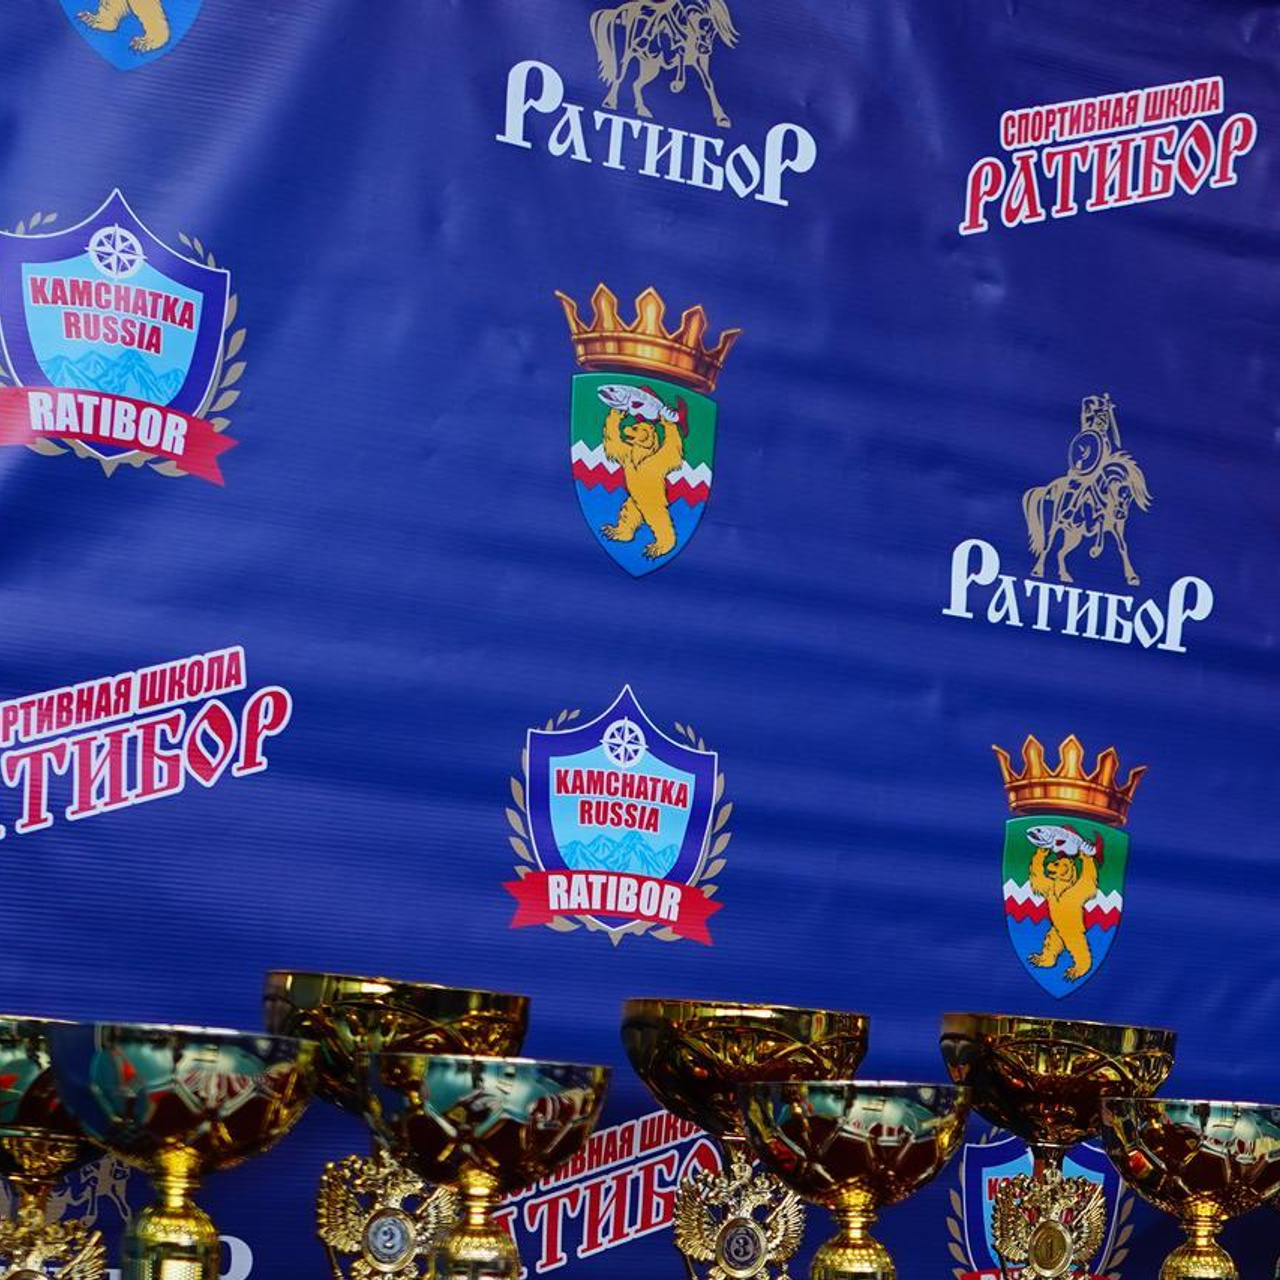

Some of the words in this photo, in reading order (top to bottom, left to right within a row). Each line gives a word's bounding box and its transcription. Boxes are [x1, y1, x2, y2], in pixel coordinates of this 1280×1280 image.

[1002, 93, 1141, 148] СПОРТИВНАЯ
[1143, 79, 1221, 123] ШКОЛА
[961, 114, 1256, 233] РАТИБОР
[29, 276, 196, 331] KAMCHATKA
[63, 310, 164, 355] RUSSIA
[27, 390, 189, 457] RATIBOR
[137, 649, 244, 711] ШКОЛА
[0, 688, 291, 838] ТИБОР
[555, 768, 689, 808] KAMCHATKA
[579, 799, 660, 832] RUSSIA
[547, 873, 683, 922] RATIBOR
